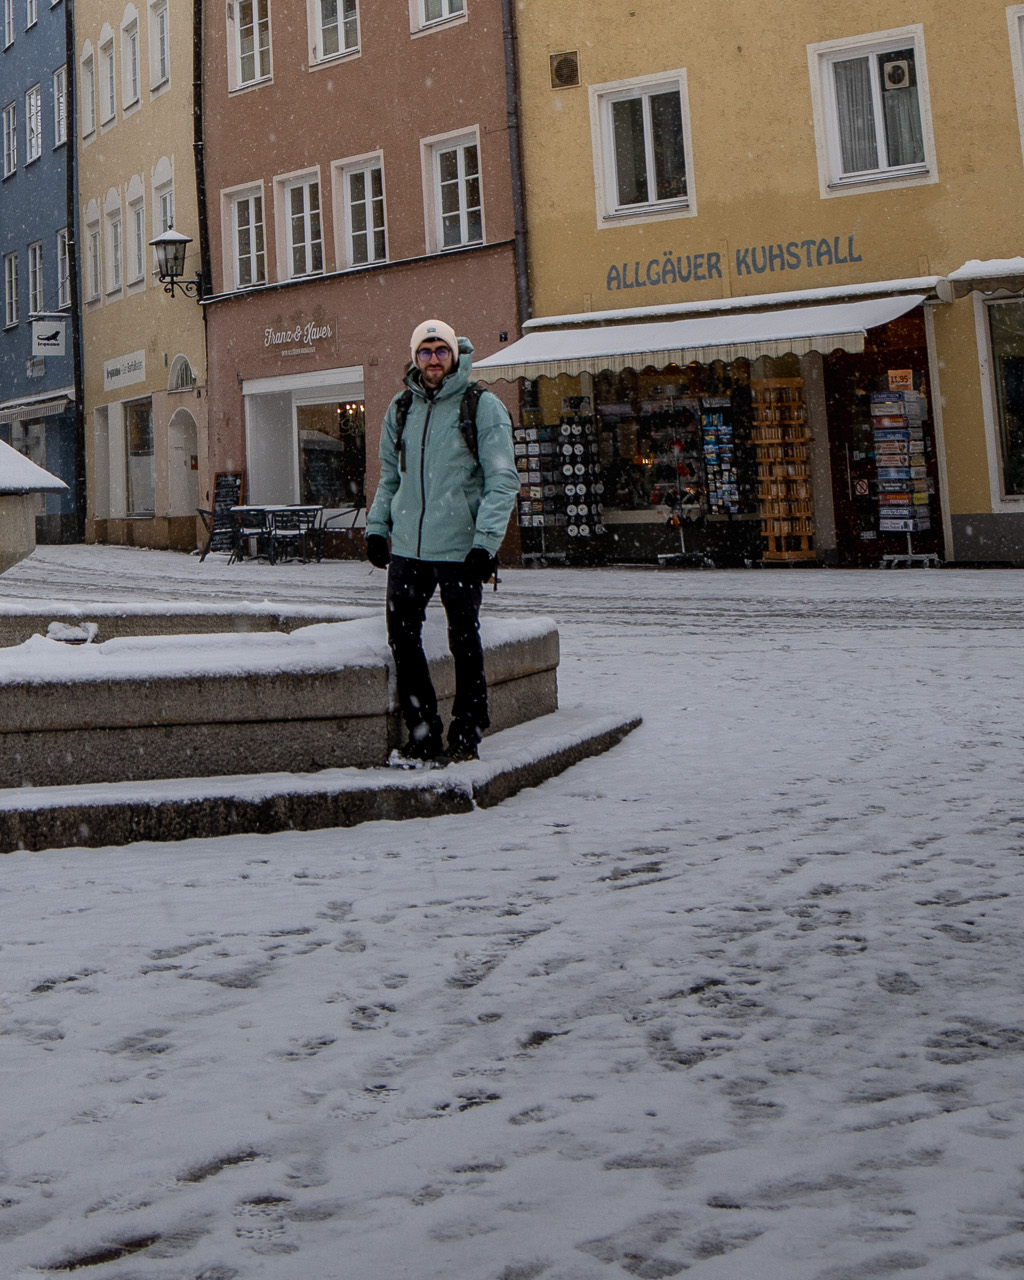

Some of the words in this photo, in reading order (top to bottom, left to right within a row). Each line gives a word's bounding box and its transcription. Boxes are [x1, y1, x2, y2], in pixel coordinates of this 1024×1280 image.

[606, 251, 723, 291] ALLGÄUER
[735, 234, 863, 276] KUHSTALL
[264, 327, 293, 347] Franz
[294, 325, 303, 342] &
[303, 321, 333, 345] Xaver
